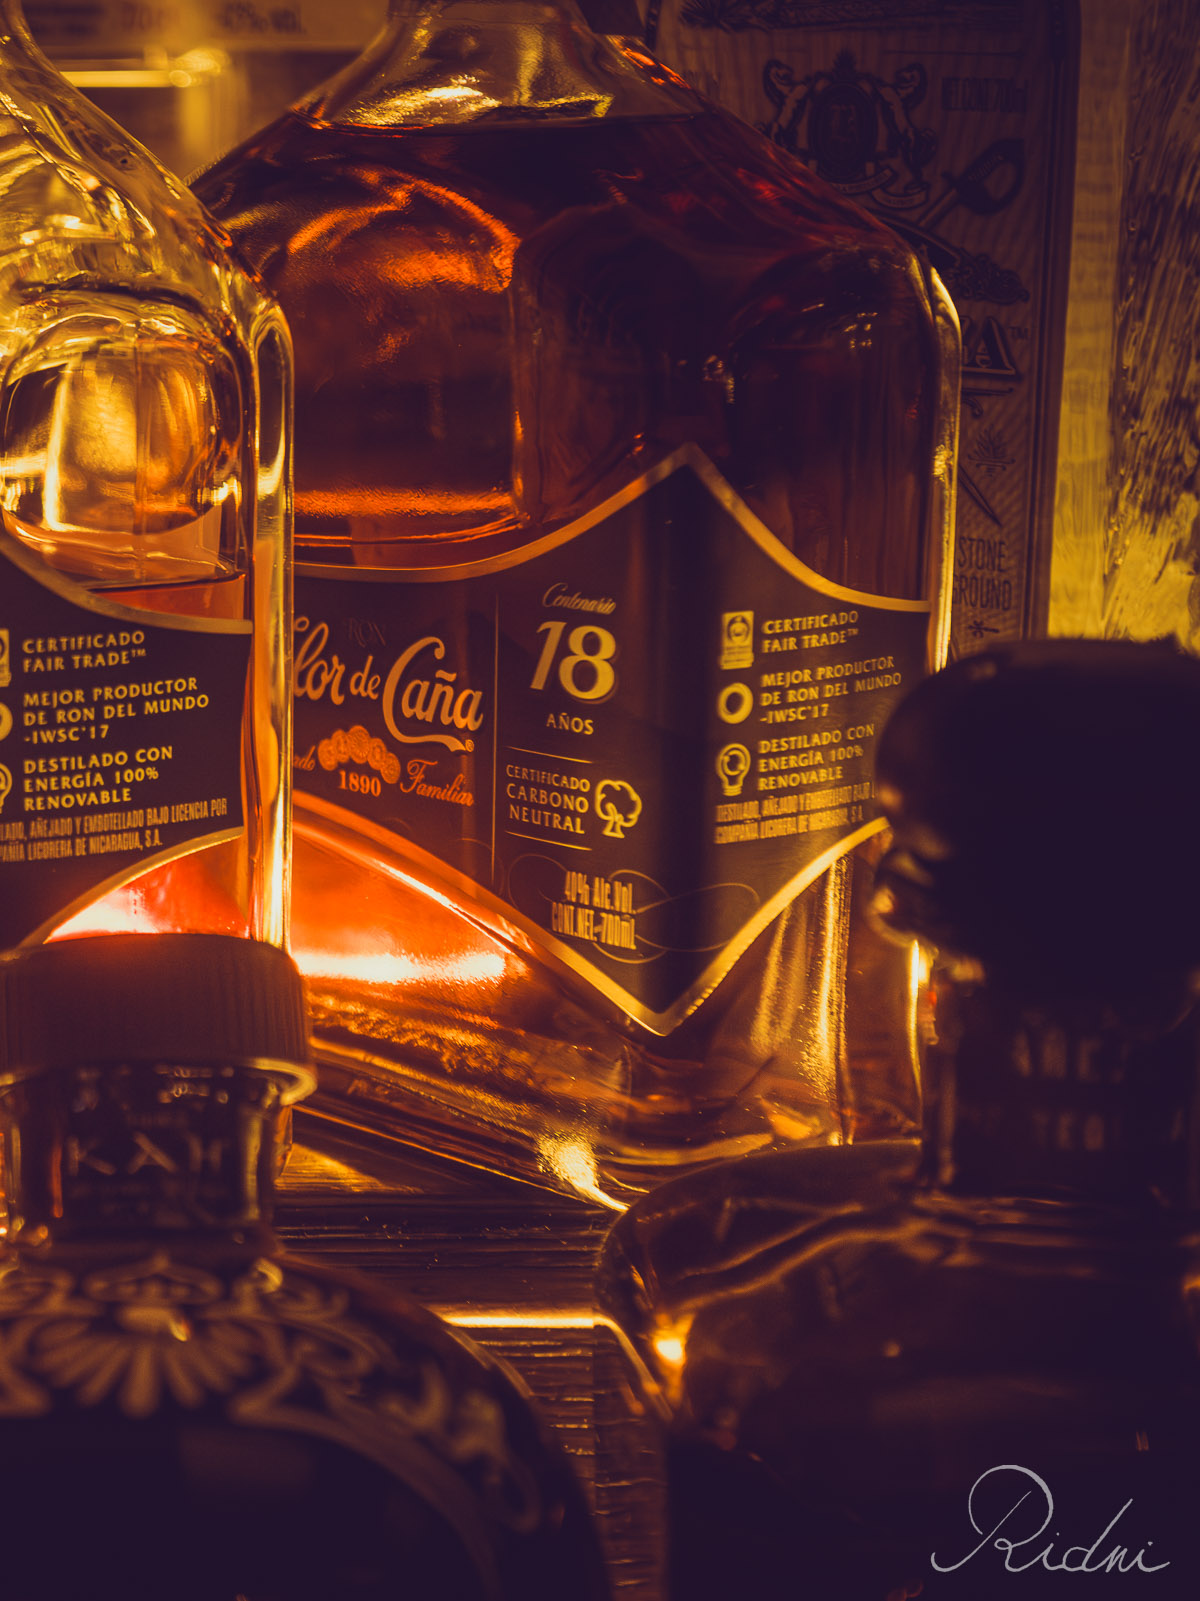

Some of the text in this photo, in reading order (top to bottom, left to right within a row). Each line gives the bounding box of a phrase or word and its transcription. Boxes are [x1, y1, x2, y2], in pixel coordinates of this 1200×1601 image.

[957, 536, 1008, 573] STONE
[541, 582, 617, 615] Centenario
[761, 610, 859, 635] CERTIFICADO
[21, 630, 146, 655] CERTIFICADO
[761, 636, 798, 653] FAIR
[22, 655, 65, 673] FAIR
[529, 620, 618, 702] 18
[760, 656, 895, 688] MEJOR PRODUCTOR
[23, 677, 199, 709] MEJOR PRODUCTOR
[293, 616, 484, 753] lor de Caña
[760, 672, 902, 707] DE RON DEL MUNDO
[23, 694, 210, 727] DE RON DEL MUNDO
[545, 711, 594, 736] AÑOS
[758, 723, 875, 754] DESTILADO CON
[23, 745, 174, 775] DESTILADO CON
[758, 745, 864, 773] ENERGÍA 100%
[23, 766, 160, 793] ENERGÍA 100%
[337, 769, 382, 798] 1890
[399, 758, 475, 807] Familiar
[505, 763, 591, 793] CERTIFICADO
[757, 766, 844, 791] RENOVABLE
[23, 787, 132, 812] RENOVABLE
[506, 782, 590, 814] CARBONO
[74, 816, 82, 836] Y
[83, 808, 145, 834] EMBOTELLADO
[146, 805, 170, 827] BAJO
[170, 800, 210, 824] LICENCIA
[210, 797, 228, 818] POR
[508, 803, 585, 835] NEUTRAL
[74, 837, 88, 857] DE
[144, 828, 164, 848] S.A.
[564, 870, 590, 906] 40%
